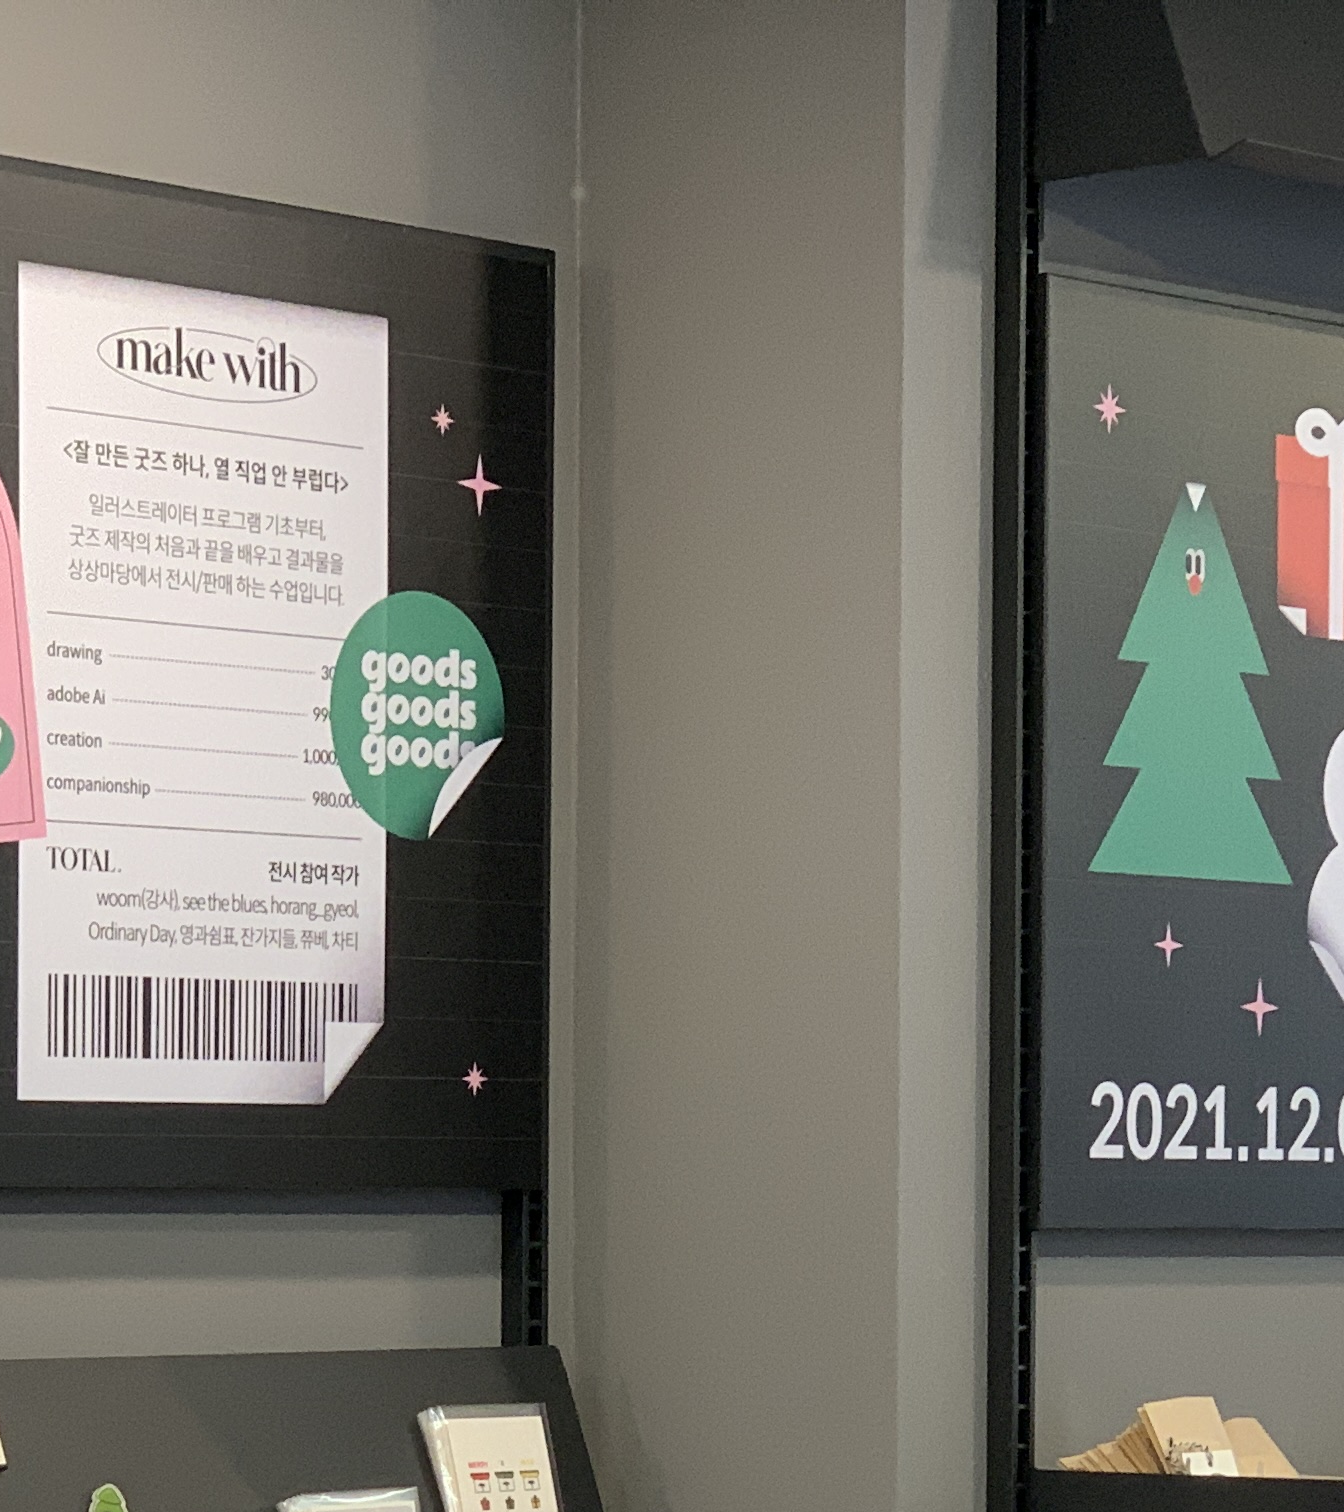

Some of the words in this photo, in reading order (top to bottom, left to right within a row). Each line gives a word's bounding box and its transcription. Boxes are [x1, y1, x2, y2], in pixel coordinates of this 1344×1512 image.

[115, 326, 216, 383] make
[222, 341, 302, 394] with
[62, 439, 91, 466] <잘
[94, 442, 130, 470] 만든
[133, 447, 169, 473] 굿즈
[171, 451, 210, 480] 하나,
[213, 456, 230, 482] 열
[233, 458, 268, 487] 직업
[271, 464, 288, 489] 안
[291, 466, 350, 495] 부럽다>
[88, 492, 198, 528] 일러스트레이터
[201, 505, 261, 535] 프로그램
[265, 512, 326, 543] 기초부터,
[68, 523, 101, 549] 굿즈
[104, 528, 151, 555] 제작의
[154, 533, 201, 560] 처음과
[204, 538, 234, 563] 끝을
[237, 541, 282, 568] 배우고
[285, 548, 344, 576] 결과물을
[67, 558, 163, 589] 상상마당에서
[166, 567, 233, 597] 전시/판매
[235, 572, 266, 599] 하는
[268, 578, 345, 607] 수업입니다.
[45, 640, 103, 666] drawing
[360, 647, 478, 693] goods
[45, 686, 92, 705] adobe
[92, 688, 107, 706] Ai
[360, 689, 478, 735] goods
[45, 731, 103, 750] creation
[45, 776, 151, 799] companionship
[45, 845, 123, 874] TOTAL.
[267, 860, 298, 884] 전시
[299, 862, 329, 885] 참여
[330, 863, 361, 887] 작가
[182, 895, 206, 912] see
[207, 892, 230, 913] the
[231, 893, 269, 916] blues,
[270, 895, 360, 923] horang_gyeol,
[87, 920, 148, 948] Ordinary
[149, 923, 178, 949] Day,
[179, 923, 239, 948] 영과쉼표,
[240, 925, 298, 950] 잔가지들,
